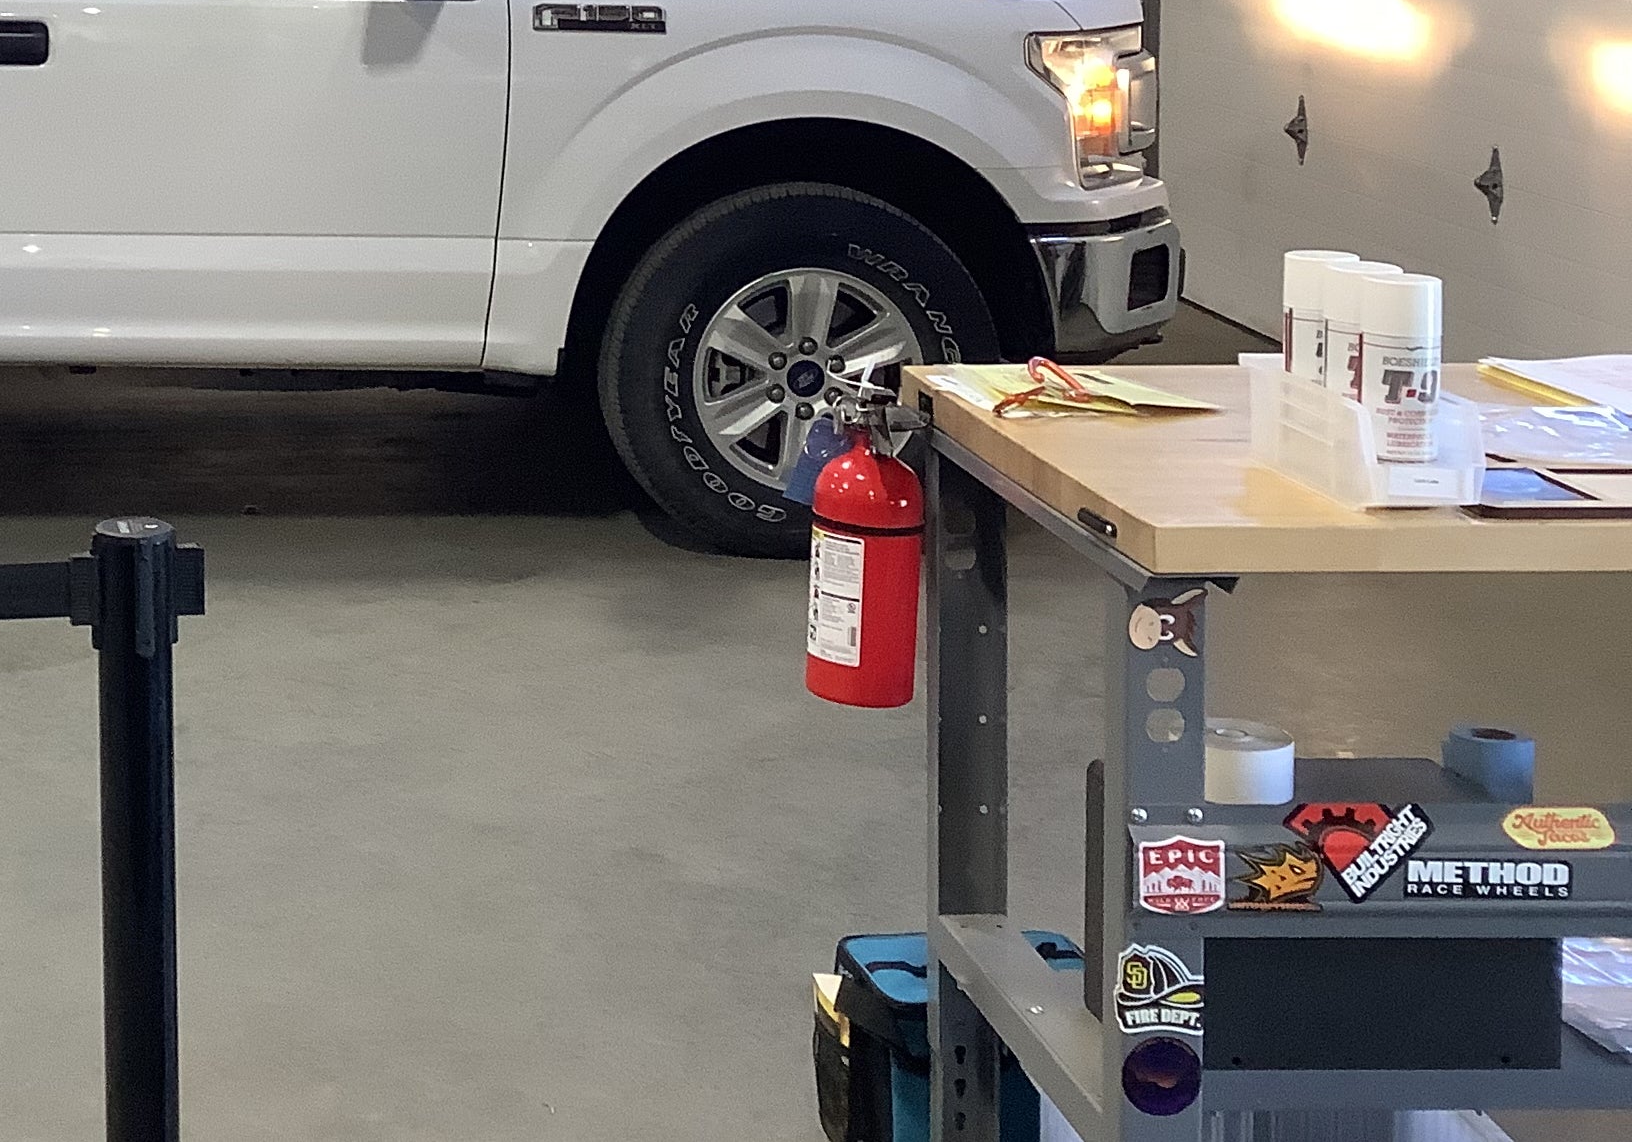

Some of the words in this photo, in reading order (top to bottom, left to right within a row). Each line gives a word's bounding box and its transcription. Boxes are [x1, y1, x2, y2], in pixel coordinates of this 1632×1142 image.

[848, 243, 962, 365] WRANG
[664, 303, 788, 522] GOODYEAR
[1511, 811, 1601, 835] Authentic
[1537, 829, 1591, 847] Tacos
[1148, 848, 1215, 865] EPIC
[1349, 816, 1429, 899] INDUSTRIES
[1407, 860, 1569, 885] METHOD
[1407, 884, 1463, 895] RACE
[1476, 885, 1569, 897] WHEELS
[1125, 1008, 1159, 1026] FIRE
[1160, 1008, 1202, 1028] DEPT.
